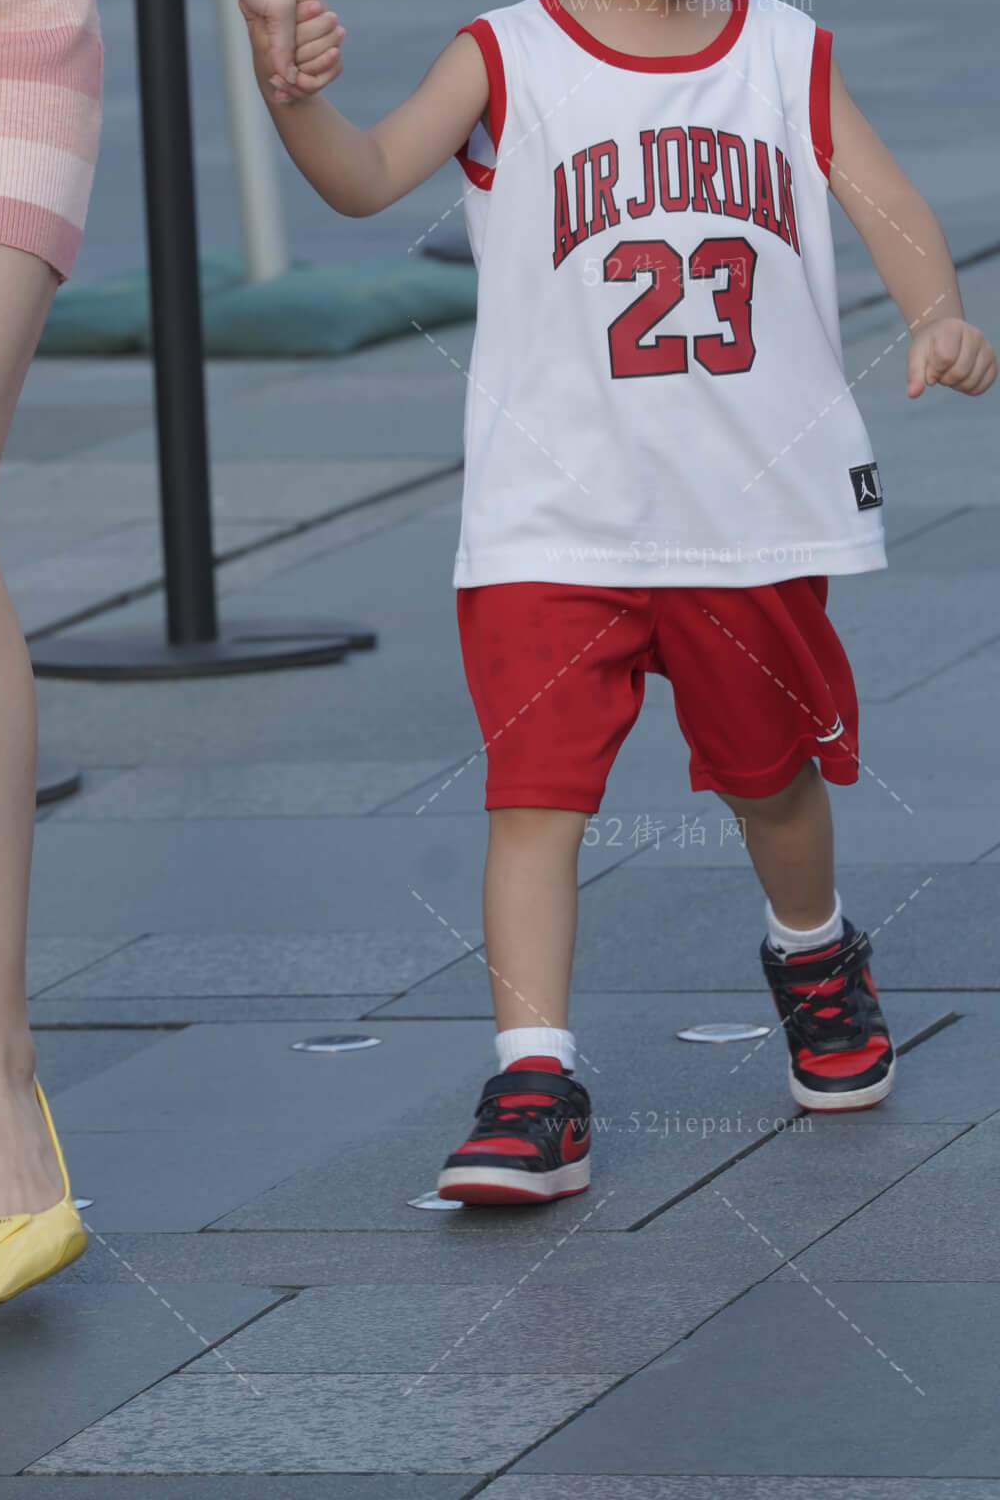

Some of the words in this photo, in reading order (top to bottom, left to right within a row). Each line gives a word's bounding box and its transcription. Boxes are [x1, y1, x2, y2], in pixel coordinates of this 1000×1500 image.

[553, 139, 620, 271] AIR
[627, 126, 801, 258] JORDAN
[603, 237, 758, 379] 23
